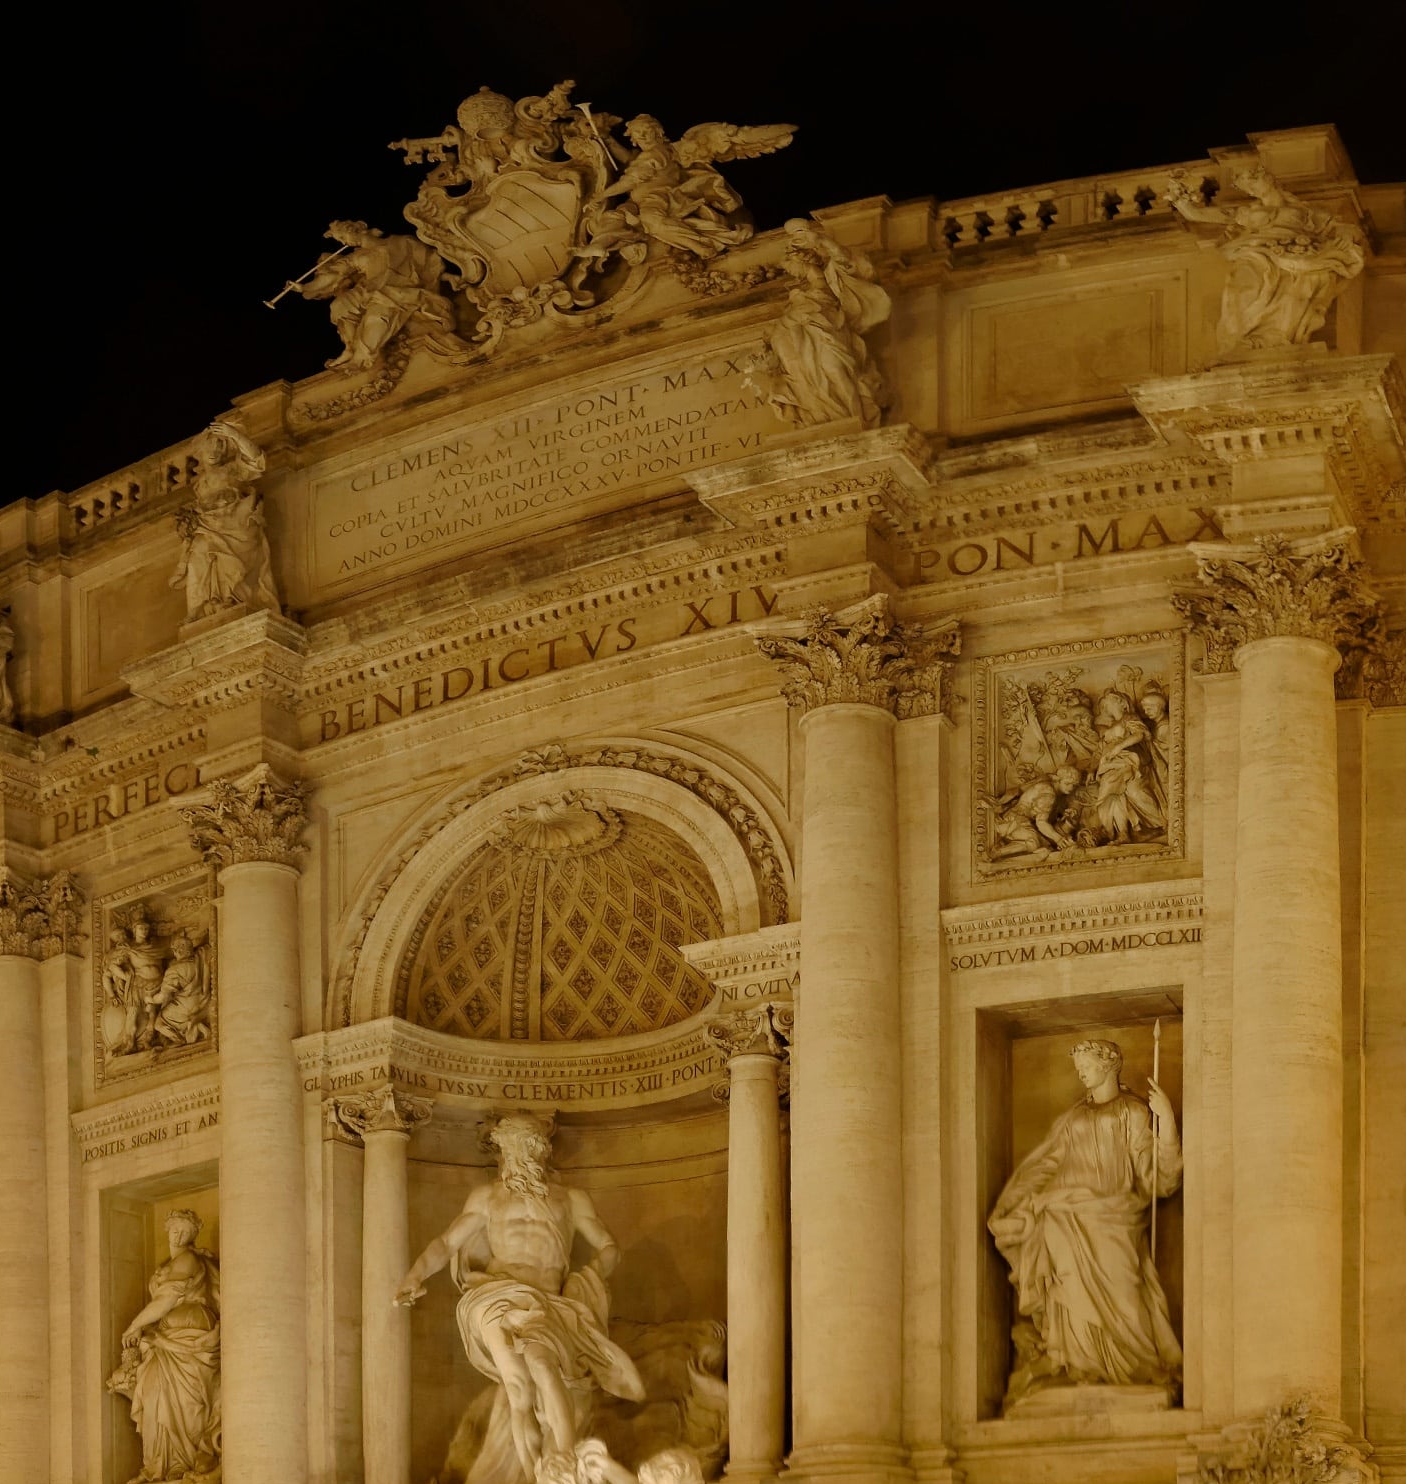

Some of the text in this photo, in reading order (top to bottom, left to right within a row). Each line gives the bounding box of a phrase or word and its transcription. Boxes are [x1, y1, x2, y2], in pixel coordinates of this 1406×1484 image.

[350, 439, 474, 492] CLEMENS
[433, 405, 646, 484] AQVAM VIRGINEM
[329, 509, 388, 538] COPIA
[397, 495, 420, 515] ET
[427, 448, 567, 504] SALVBRITATE
[380, 426, 713, 538] CVLTV MAGNIFICO ORNAVIT
[337, 542, 397, 575] ANNO
[405, 512, 482, 550] DOMINI
[1072, 506, 1231, 559] MAX
[318, 585, 778, 744] BENEDICTVS XIV
[52, 763, 203, 845] PERFECI
[950, 945, 1035, 971] SOLVTVM
[721, 986, 738, 1002] NI
[370, 1063, 427, 1088] TABVLIS
[437, 1077, 489, 1097] IVSSV
[84, 1111, 218, 1162] POSITIS SIGNIS ET AN
